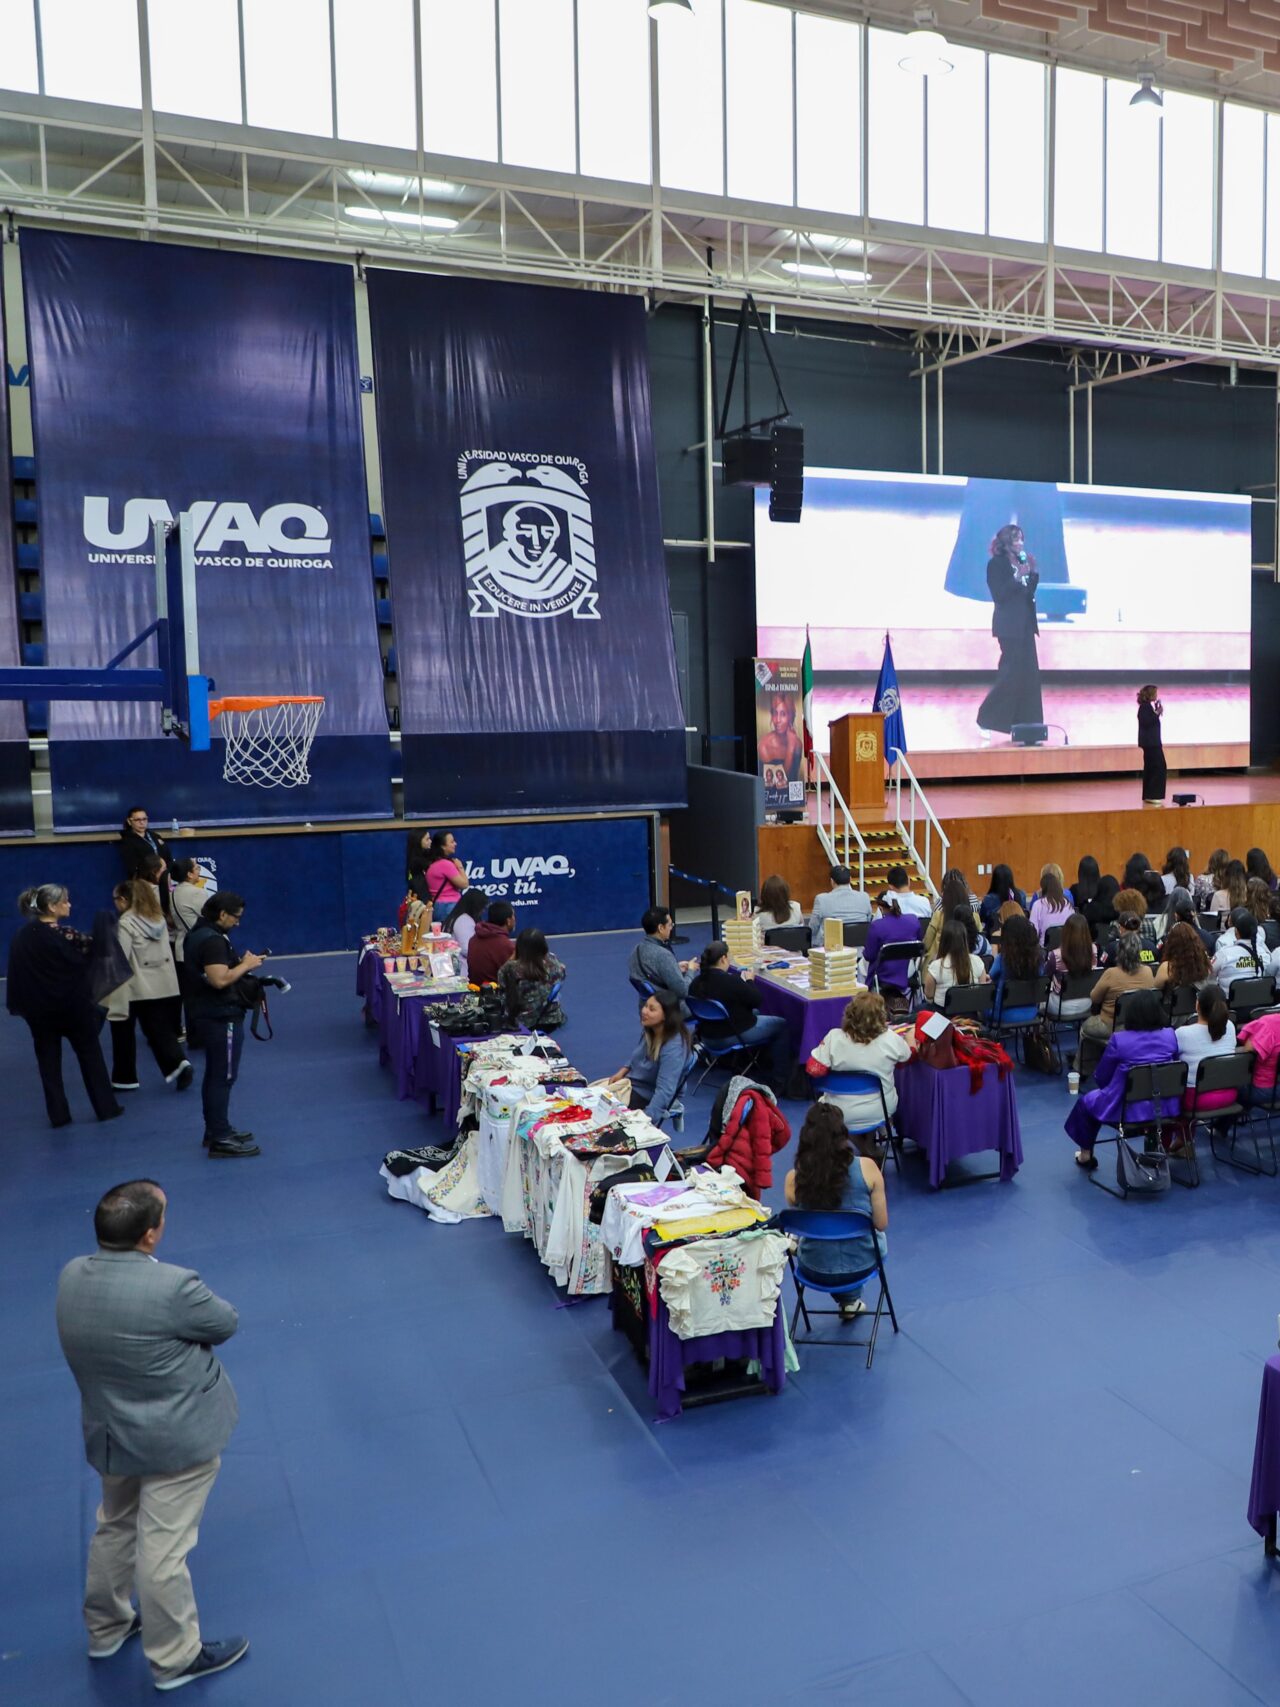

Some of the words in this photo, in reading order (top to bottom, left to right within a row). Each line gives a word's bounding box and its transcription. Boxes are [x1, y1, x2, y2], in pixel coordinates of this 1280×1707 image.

[457, 450, 506, 480] UNIVERSIDAD
[507, 452, 540, 464] VASCO
[541, 454, 553, 464] DE
[554, 455, 589, 485] QUIROGA
[83, 496, 332, 554] UVAQ
[88, 553, 158, 565] UNIVERSI
[245, 557, 264, 568] DE
[267, 558, 333, 569] QUIROGA
[483, 578, 527, 611] EDUCERE
[529, 602, 541, 612] IN
[542, 581, 583, 611] VERITATE
[491, 854, 576, 878] UVAQ,
[513, 876, 542, 895] tú.
